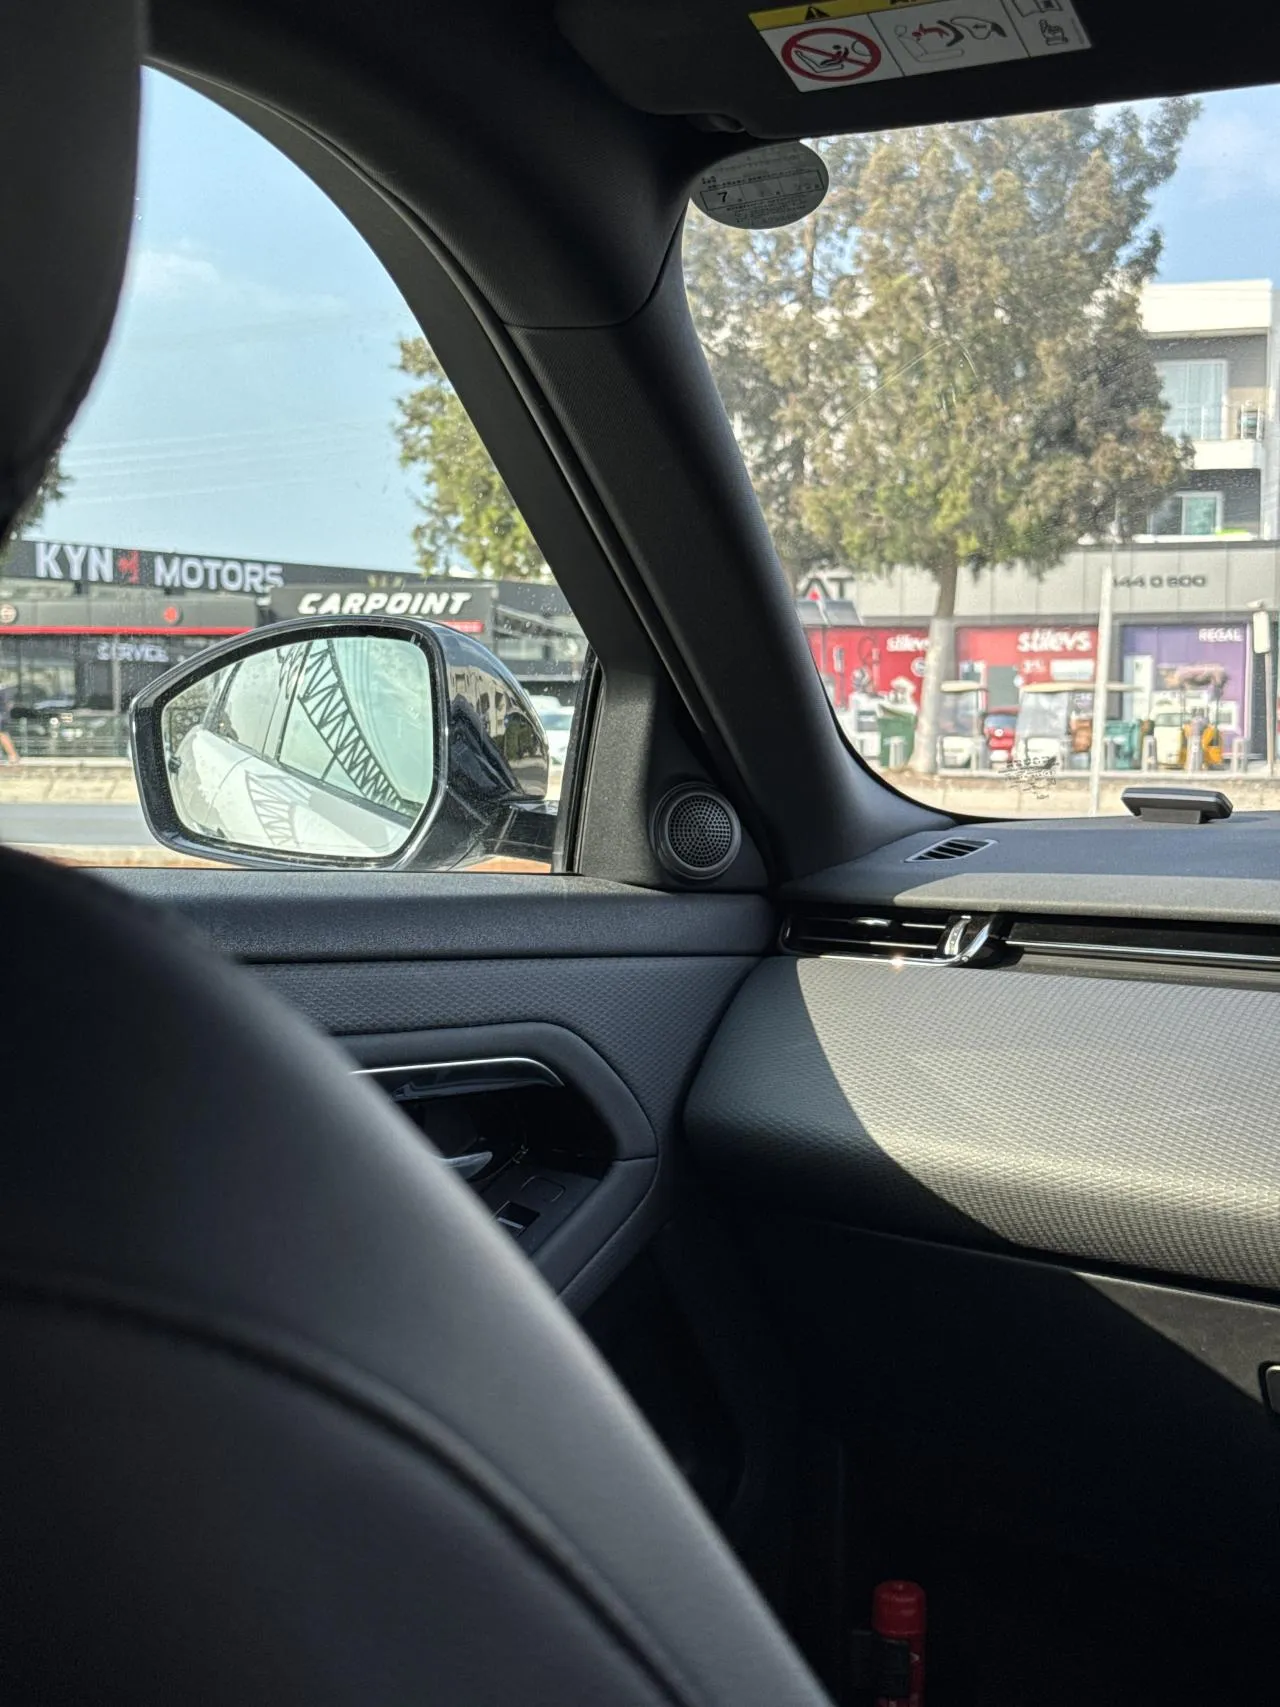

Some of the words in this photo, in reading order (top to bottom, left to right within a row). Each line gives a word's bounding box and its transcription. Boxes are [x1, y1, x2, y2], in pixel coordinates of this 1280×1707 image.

[35, 542, 114, 583] KYN
[154, 555, 284, 594] MOTORS
[298, 592, 473, 615] CARPOINT
[1199, 627, 1244, 642] REGAL
